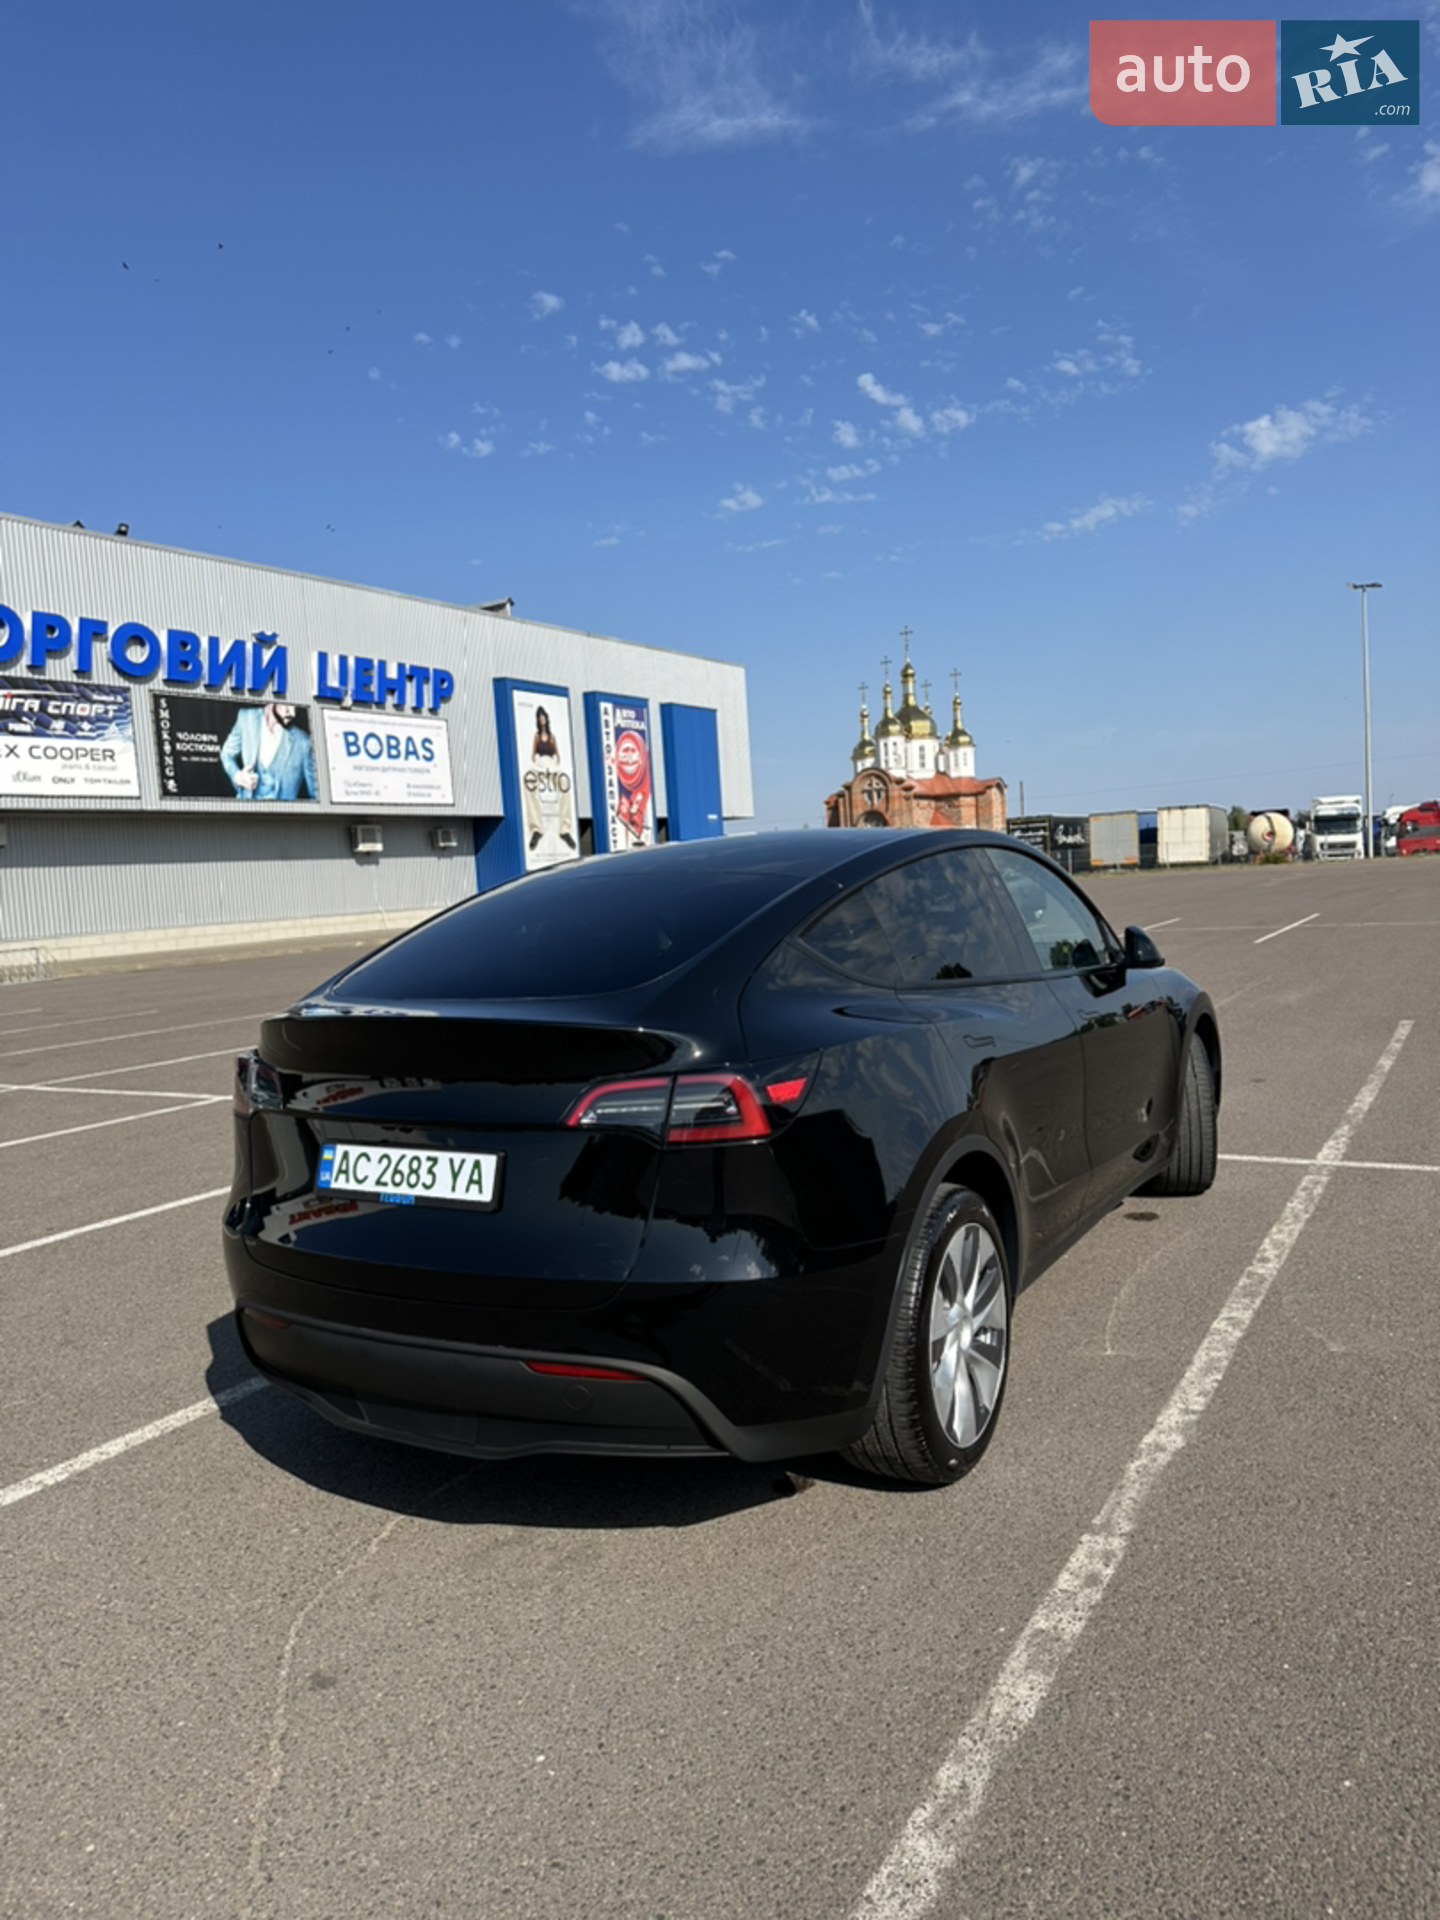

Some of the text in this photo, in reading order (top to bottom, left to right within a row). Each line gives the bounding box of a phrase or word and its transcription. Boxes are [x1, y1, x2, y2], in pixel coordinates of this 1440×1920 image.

[316, 650, 454, 710] ЦЕНТР
[47, 700, 119, 718] СПОРТ
[28, 744, 116, 762] COOPER
[342, 731, 435, 762] BOBAS
[523, 768, 571, 793] estro
[334, 1149, 484, 1195] AC 2683 YA
